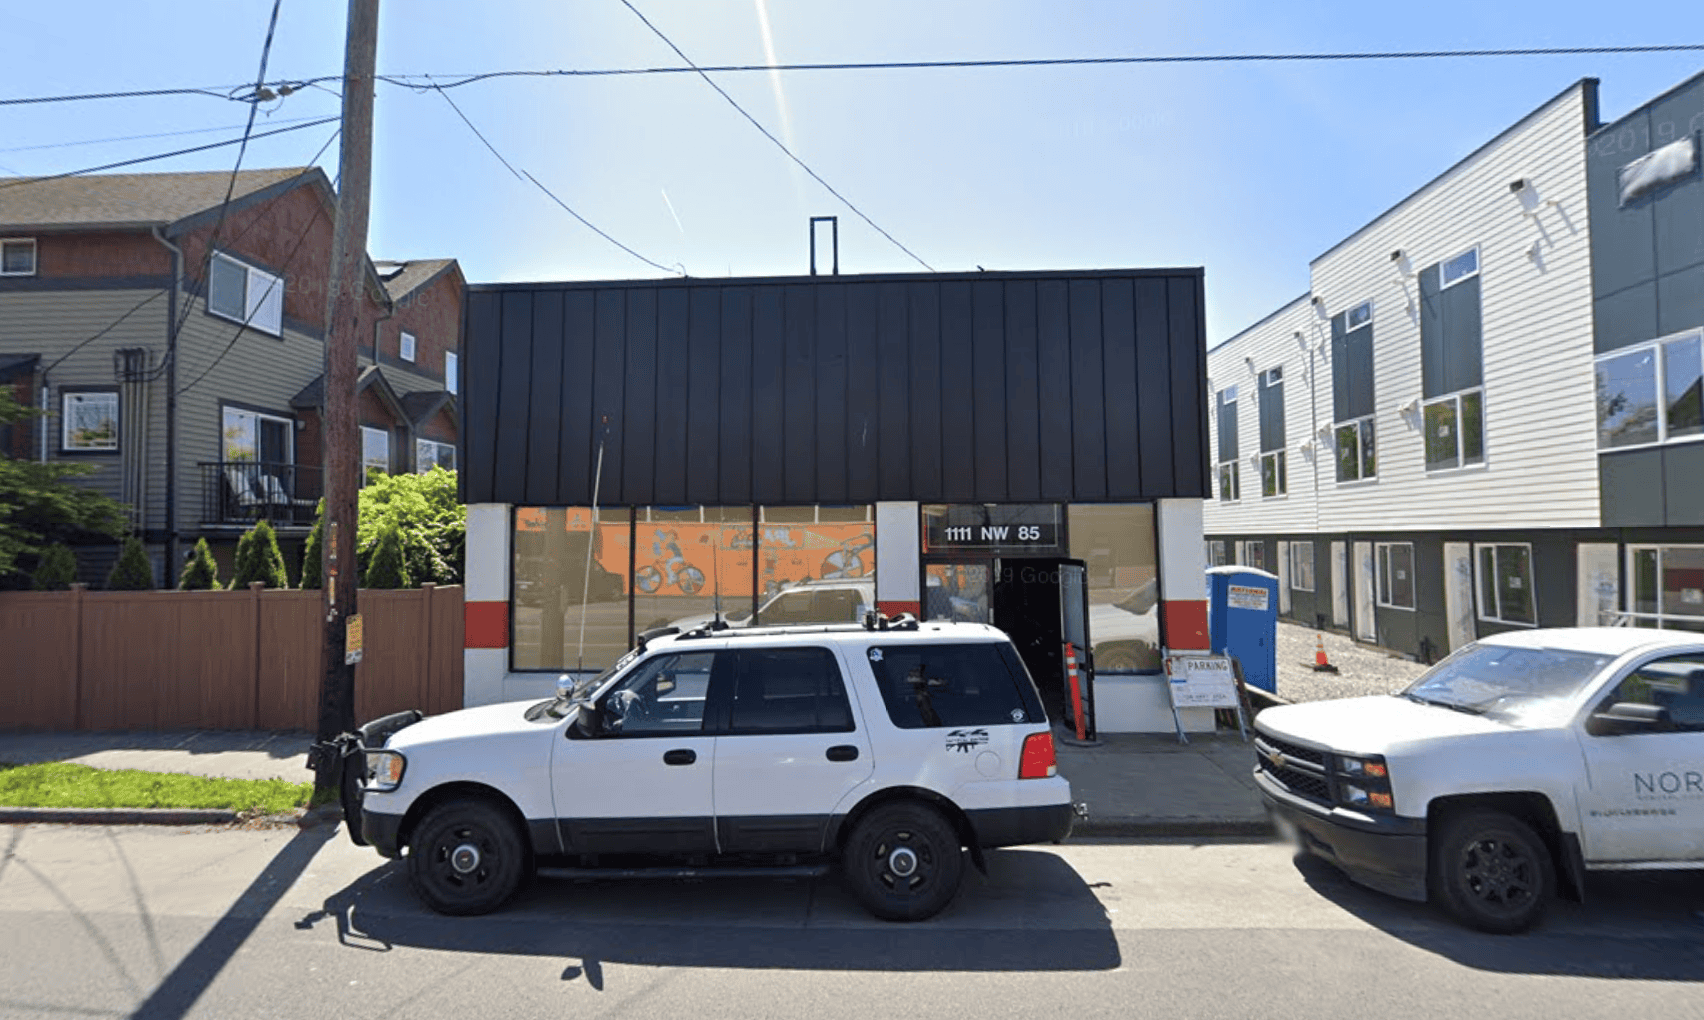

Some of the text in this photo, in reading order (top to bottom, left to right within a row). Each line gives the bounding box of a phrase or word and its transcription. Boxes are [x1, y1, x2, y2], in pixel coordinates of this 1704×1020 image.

[945, 526, 1040, 541] 1111 NW 85
[1188, 661, 1228, 671] PARKING
[1634, 771, 1704, 793] NOR
